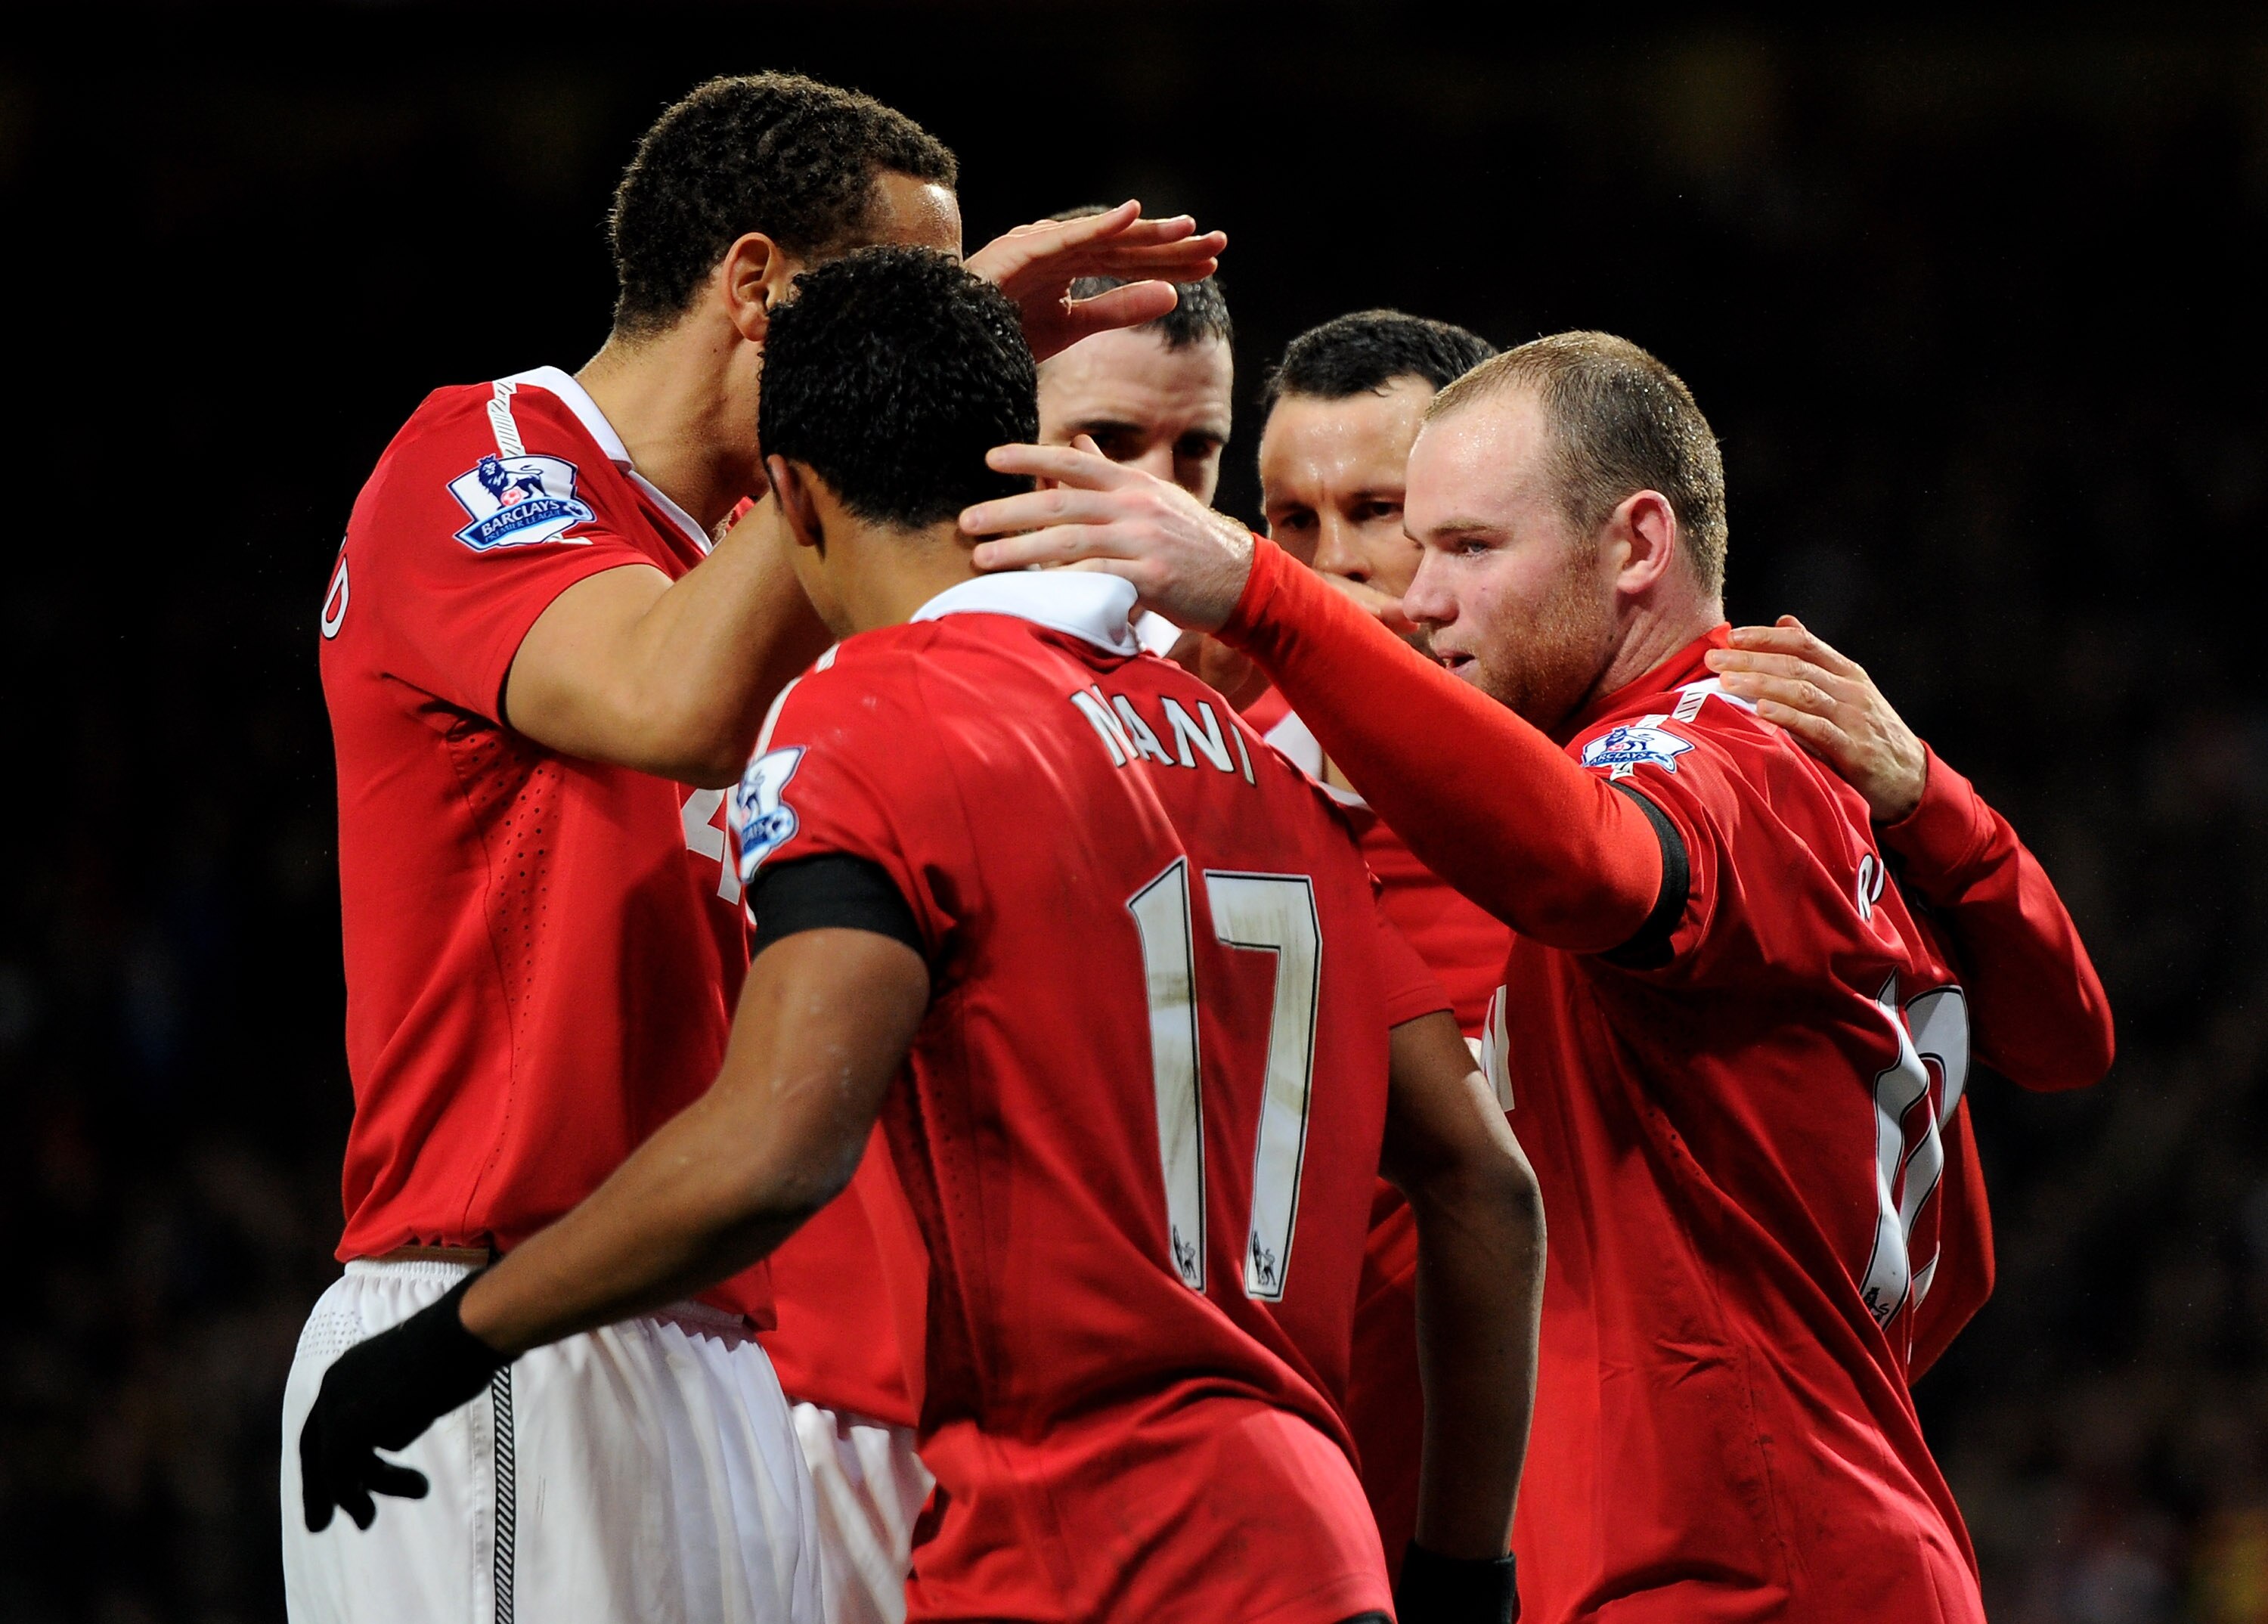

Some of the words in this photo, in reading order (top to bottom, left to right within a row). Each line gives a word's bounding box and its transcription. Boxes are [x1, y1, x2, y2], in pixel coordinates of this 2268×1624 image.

[482, 501, 560, 537] BARCLAYS
[485, 522, 525, 543] PREMIER
[525, 511, 561, 526] LEAGUE
[1070, 683, 1256, 786] NANI
[1126, 855, 1322, 1301] 17
